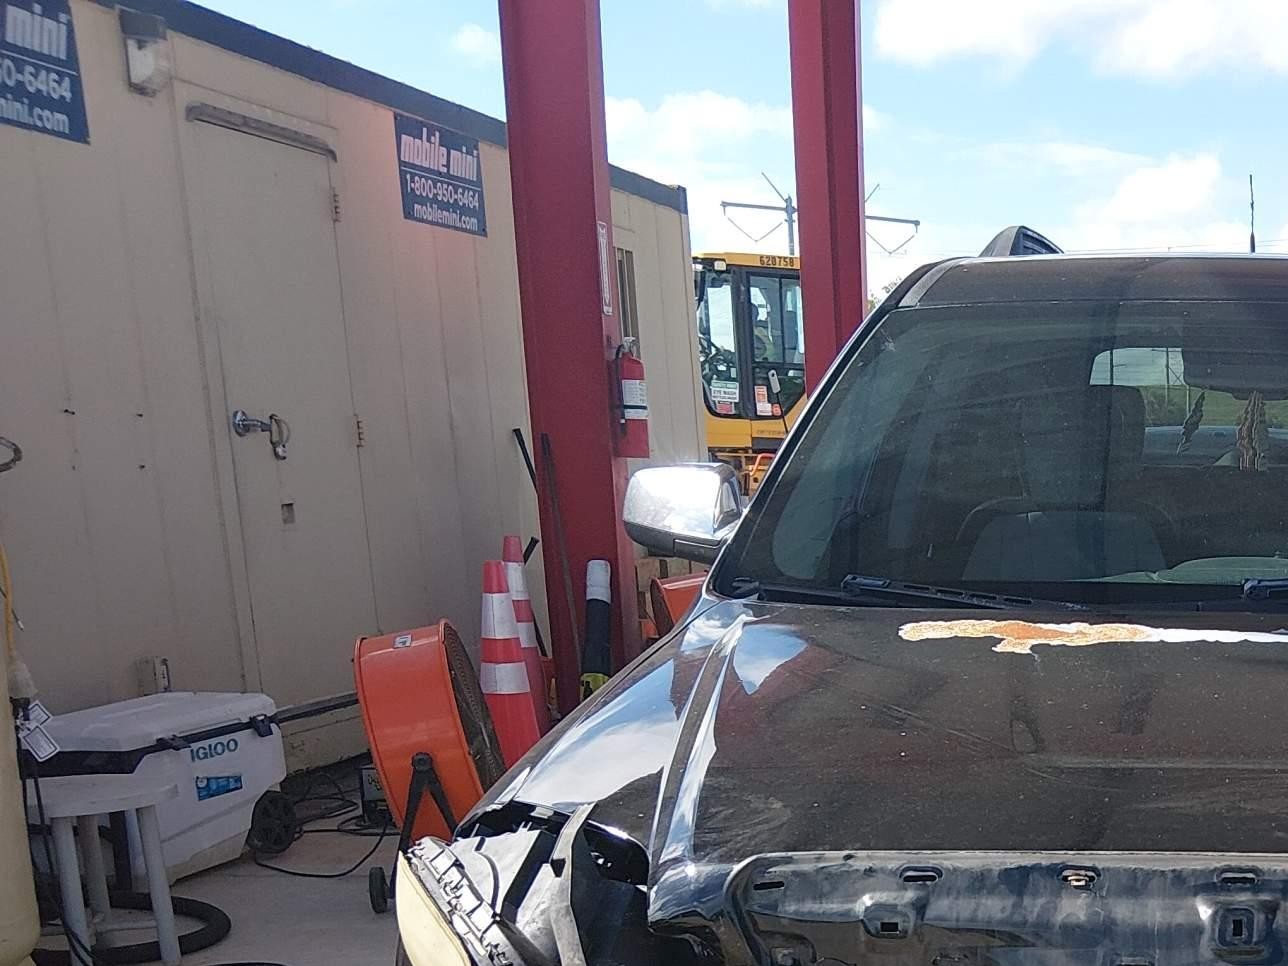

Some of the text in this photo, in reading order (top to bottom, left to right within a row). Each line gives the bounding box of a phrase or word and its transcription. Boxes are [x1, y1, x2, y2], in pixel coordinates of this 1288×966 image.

[5, 2, 71, 60] mini
[0, 58, 72, 103] 0-6464
[400, 127, 479, 181] mobile mini
[406, 173, 480, 211] 1-800-950-6464
[414, 202, 479, 231] mobilemini.com
[190, 738, 239, 763] IGLOO
